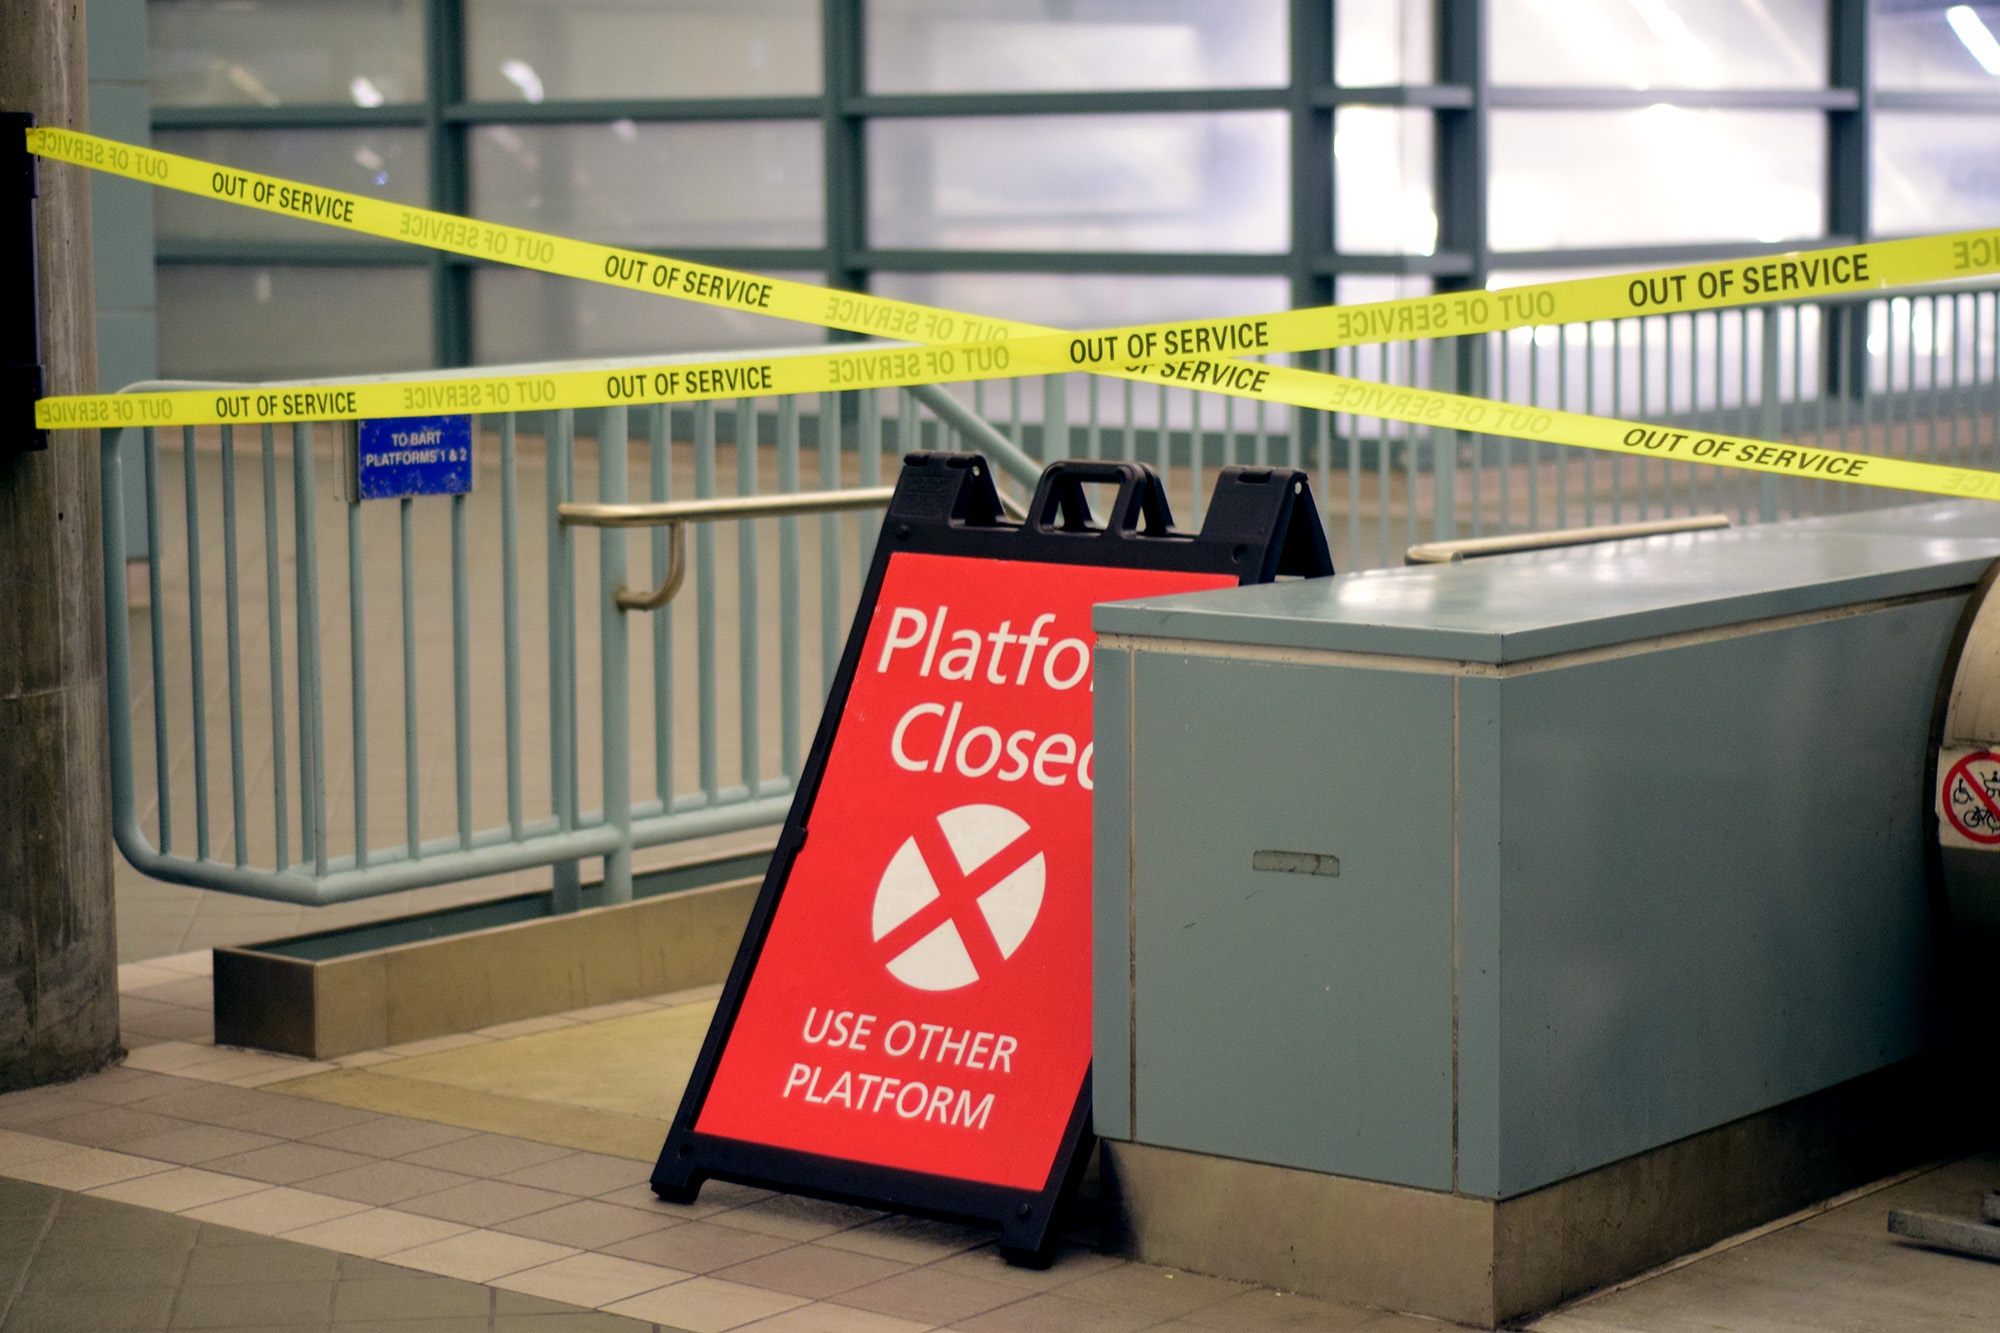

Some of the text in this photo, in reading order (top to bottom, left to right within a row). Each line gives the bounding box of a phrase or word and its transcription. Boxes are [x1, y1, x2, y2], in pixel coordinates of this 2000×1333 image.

[212, 172, 355, 223] OUT OF SERVICE
[604, 255, 773, 308] OUT OF SERVICE
[1628, 253, 1869, 306] OUT OF SERVICE
[1070, 322, 1268, 363] OUT OF SERVICE
[216, 392, 358, 418] OUT OF SERVICE
[607, 366, 772, 399] OUT OF SERVICE
[366, 449, 437, 467] PLATFORMS
[448, 448, 458, 462] &
[460, 448, 466, 461] 2
[392, 431, 442, 446] TO BART
[1623, 428, 1868, 478] OUT OF SERVICE
[877, 606, 1093, 692] Platfo
[803, 1007, 1018, 1073] USE OTHER
[783, 1063, 995, 1130] PLATFORM
